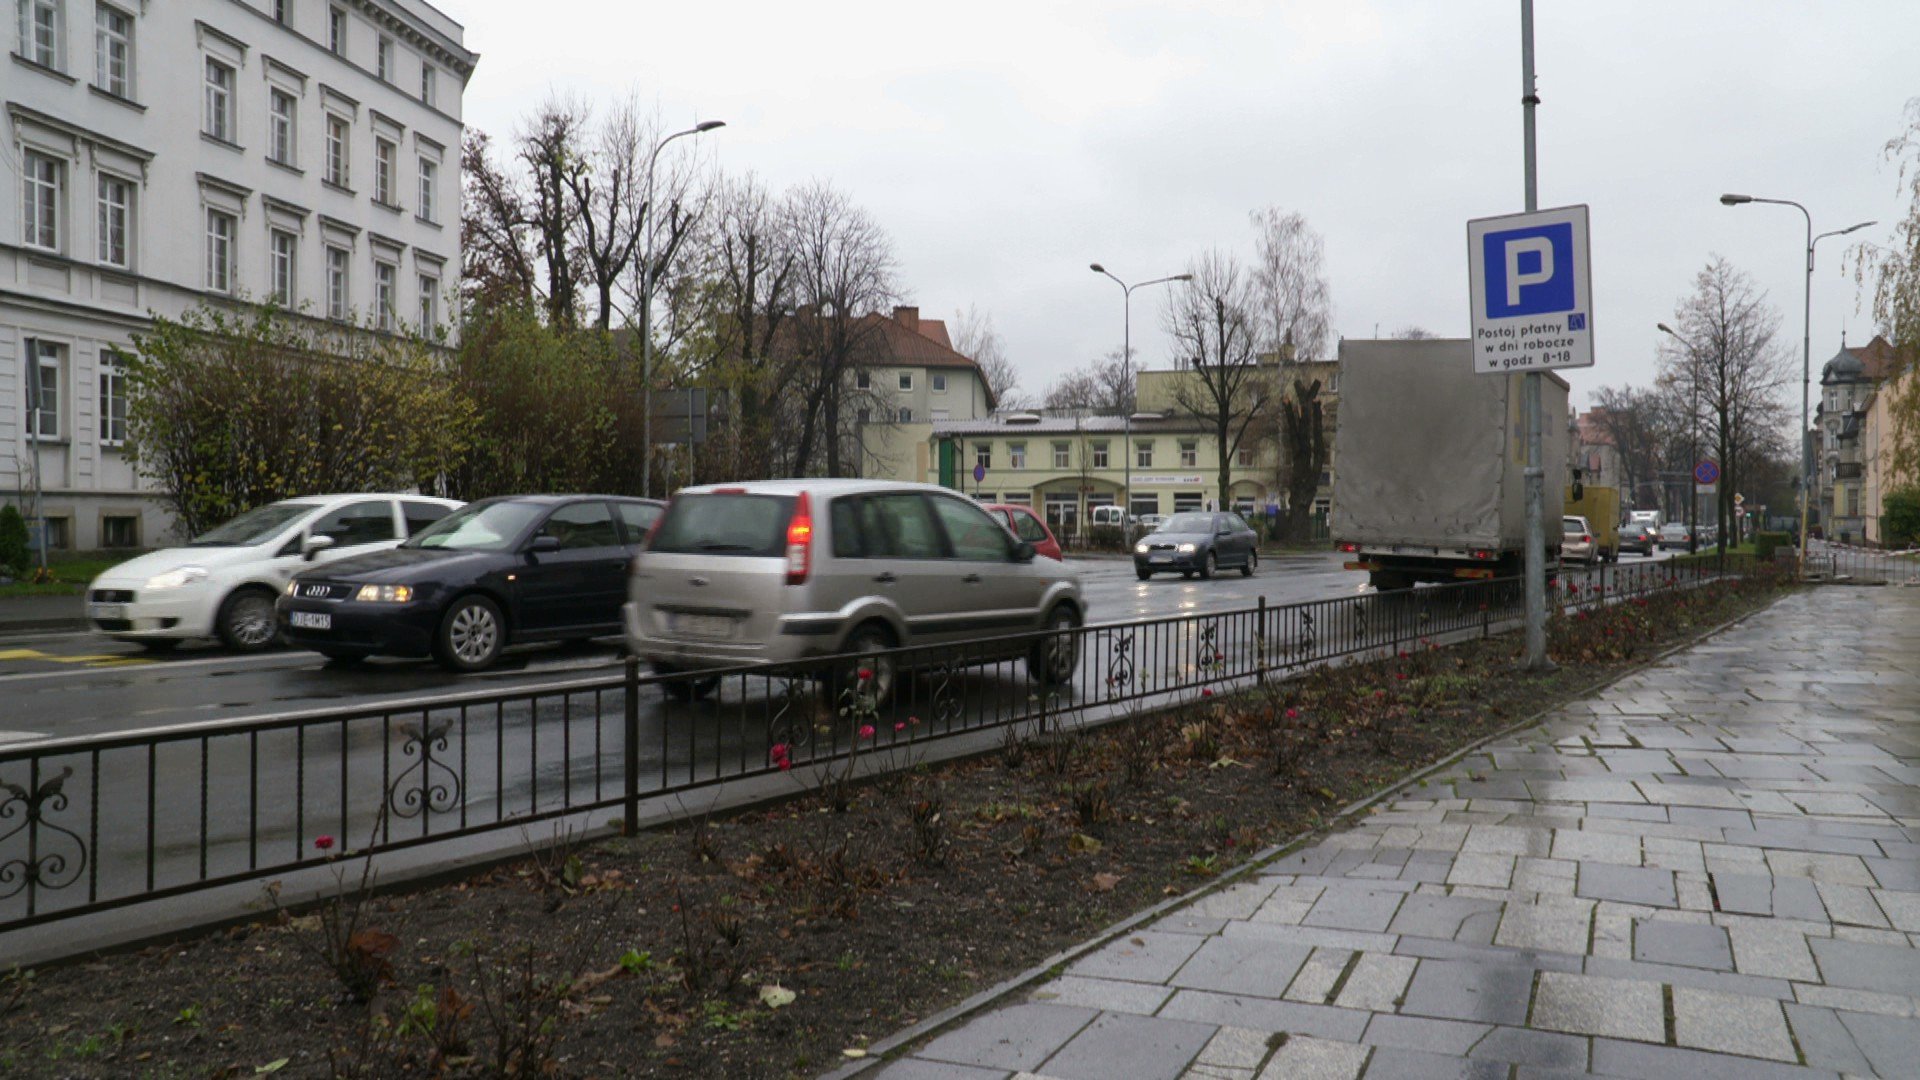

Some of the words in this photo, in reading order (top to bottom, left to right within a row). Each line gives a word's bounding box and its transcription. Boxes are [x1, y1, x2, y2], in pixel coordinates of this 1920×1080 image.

[1504, 236, 1554, 306] P
[1521, 324, 1562, 338] płatny
[1485, 345, 1494, 353] w
[1499, 341, 1518, 352] dni
[1524, 338, 1574, 350] robocze
[1503, 355, 1533, 368] godz
[1543, 351, 1570, 363] 8-18
